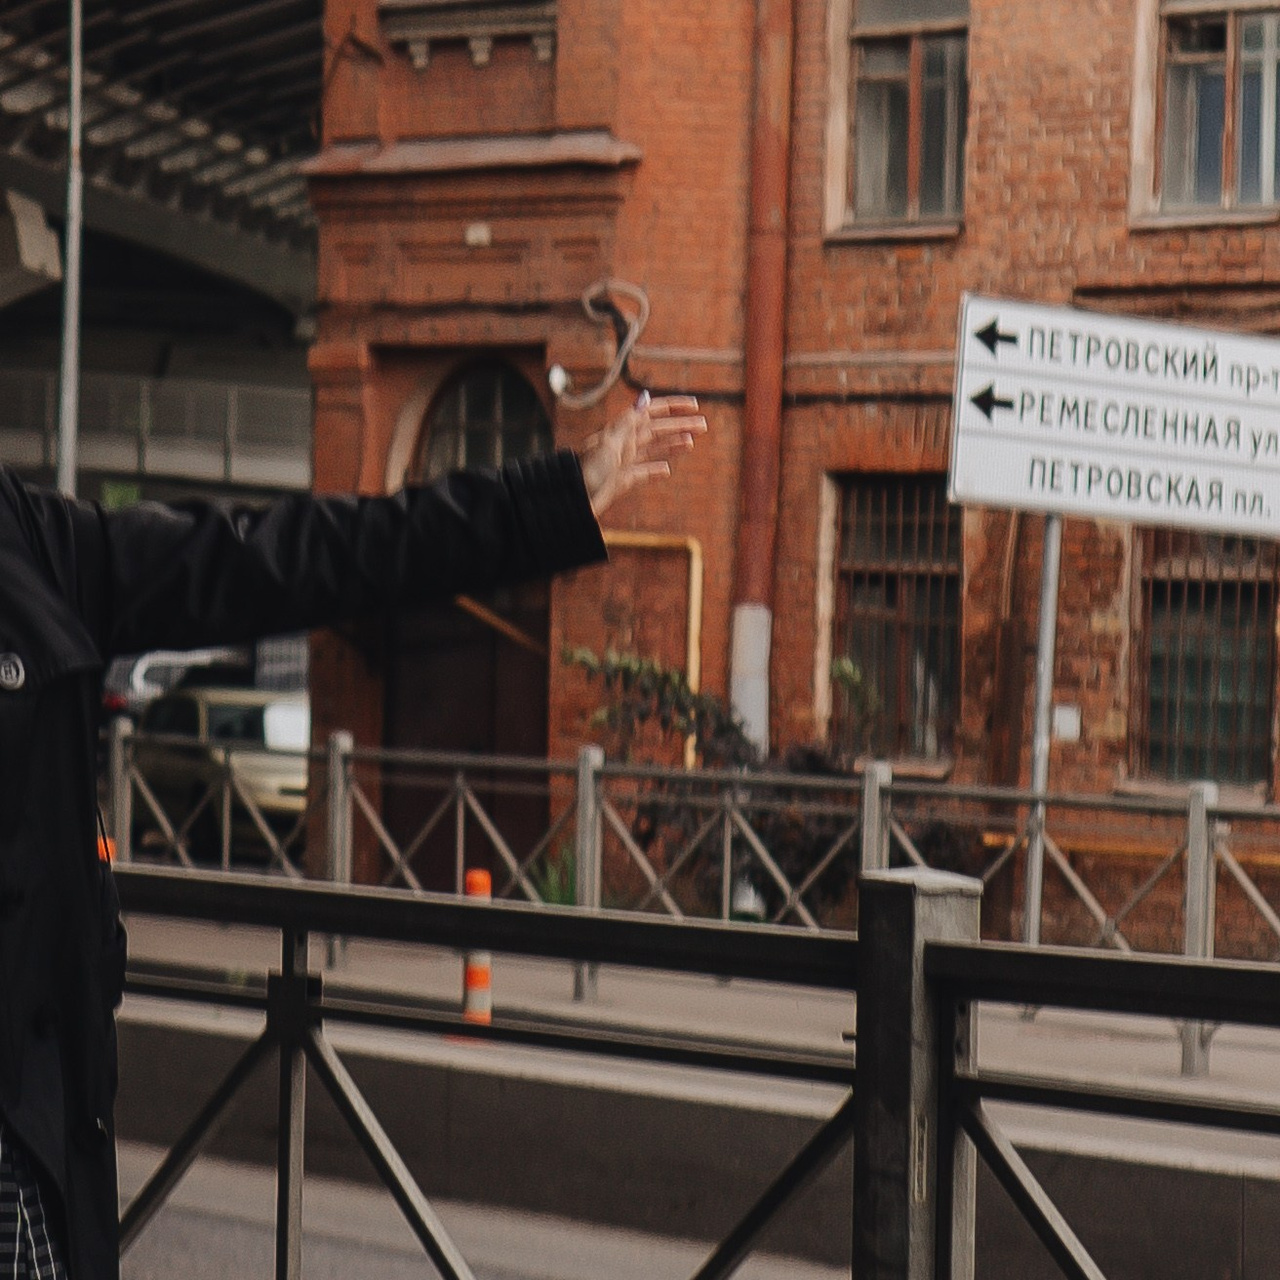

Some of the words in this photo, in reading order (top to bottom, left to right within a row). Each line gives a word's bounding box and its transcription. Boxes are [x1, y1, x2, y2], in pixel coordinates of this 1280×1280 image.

[1028, 324, 1218, 384] ПЕТРОВСКИЙ
[1019, 390, 1240, 453] РЕМЕСЛЕННАЯ
[1028, 457, 1223, 515] ПЕТРОВСКАЯ
[1233, 489, 1270, 517] пл.
